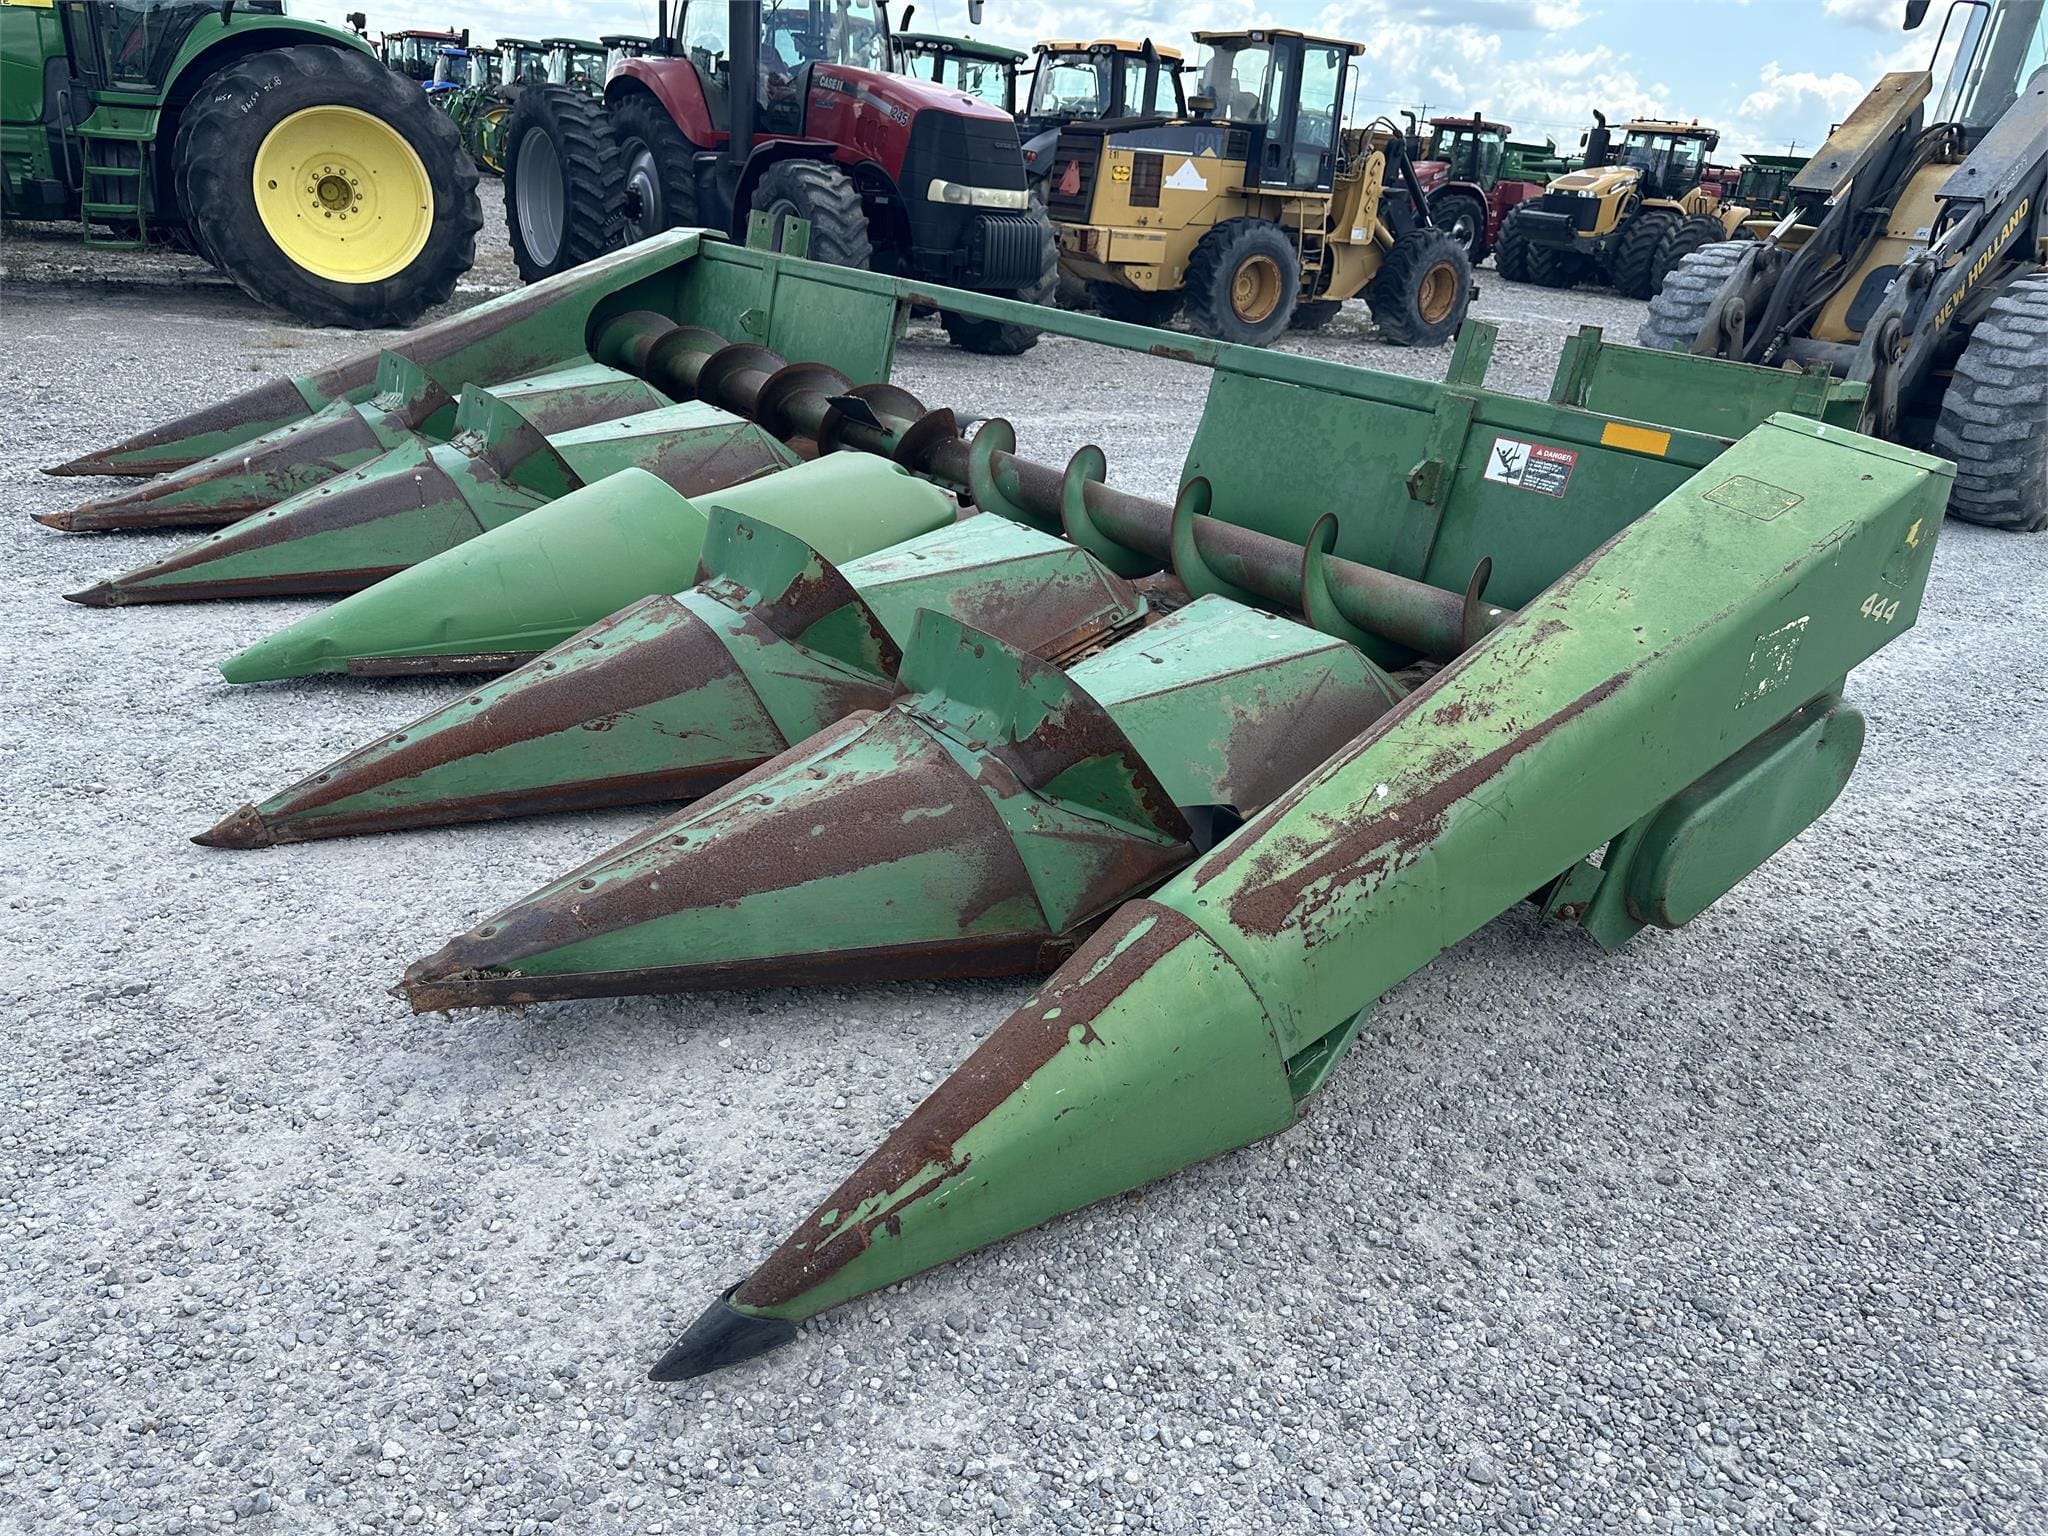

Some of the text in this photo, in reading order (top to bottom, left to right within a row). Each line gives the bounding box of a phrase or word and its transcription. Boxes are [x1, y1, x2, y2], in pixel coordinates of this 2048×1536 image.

[820, 76, 836, 90] CASE
[891, 105, 910, 127] 245
[1194, 132, 1223, 157] CAT
[1934, 283, 1966, 332] NEW
[1967, 198, 2029, 288] HOLLAND
[1544, 450, 1572, 461] DANGER
[1860, 593, 1900, 624] 444
